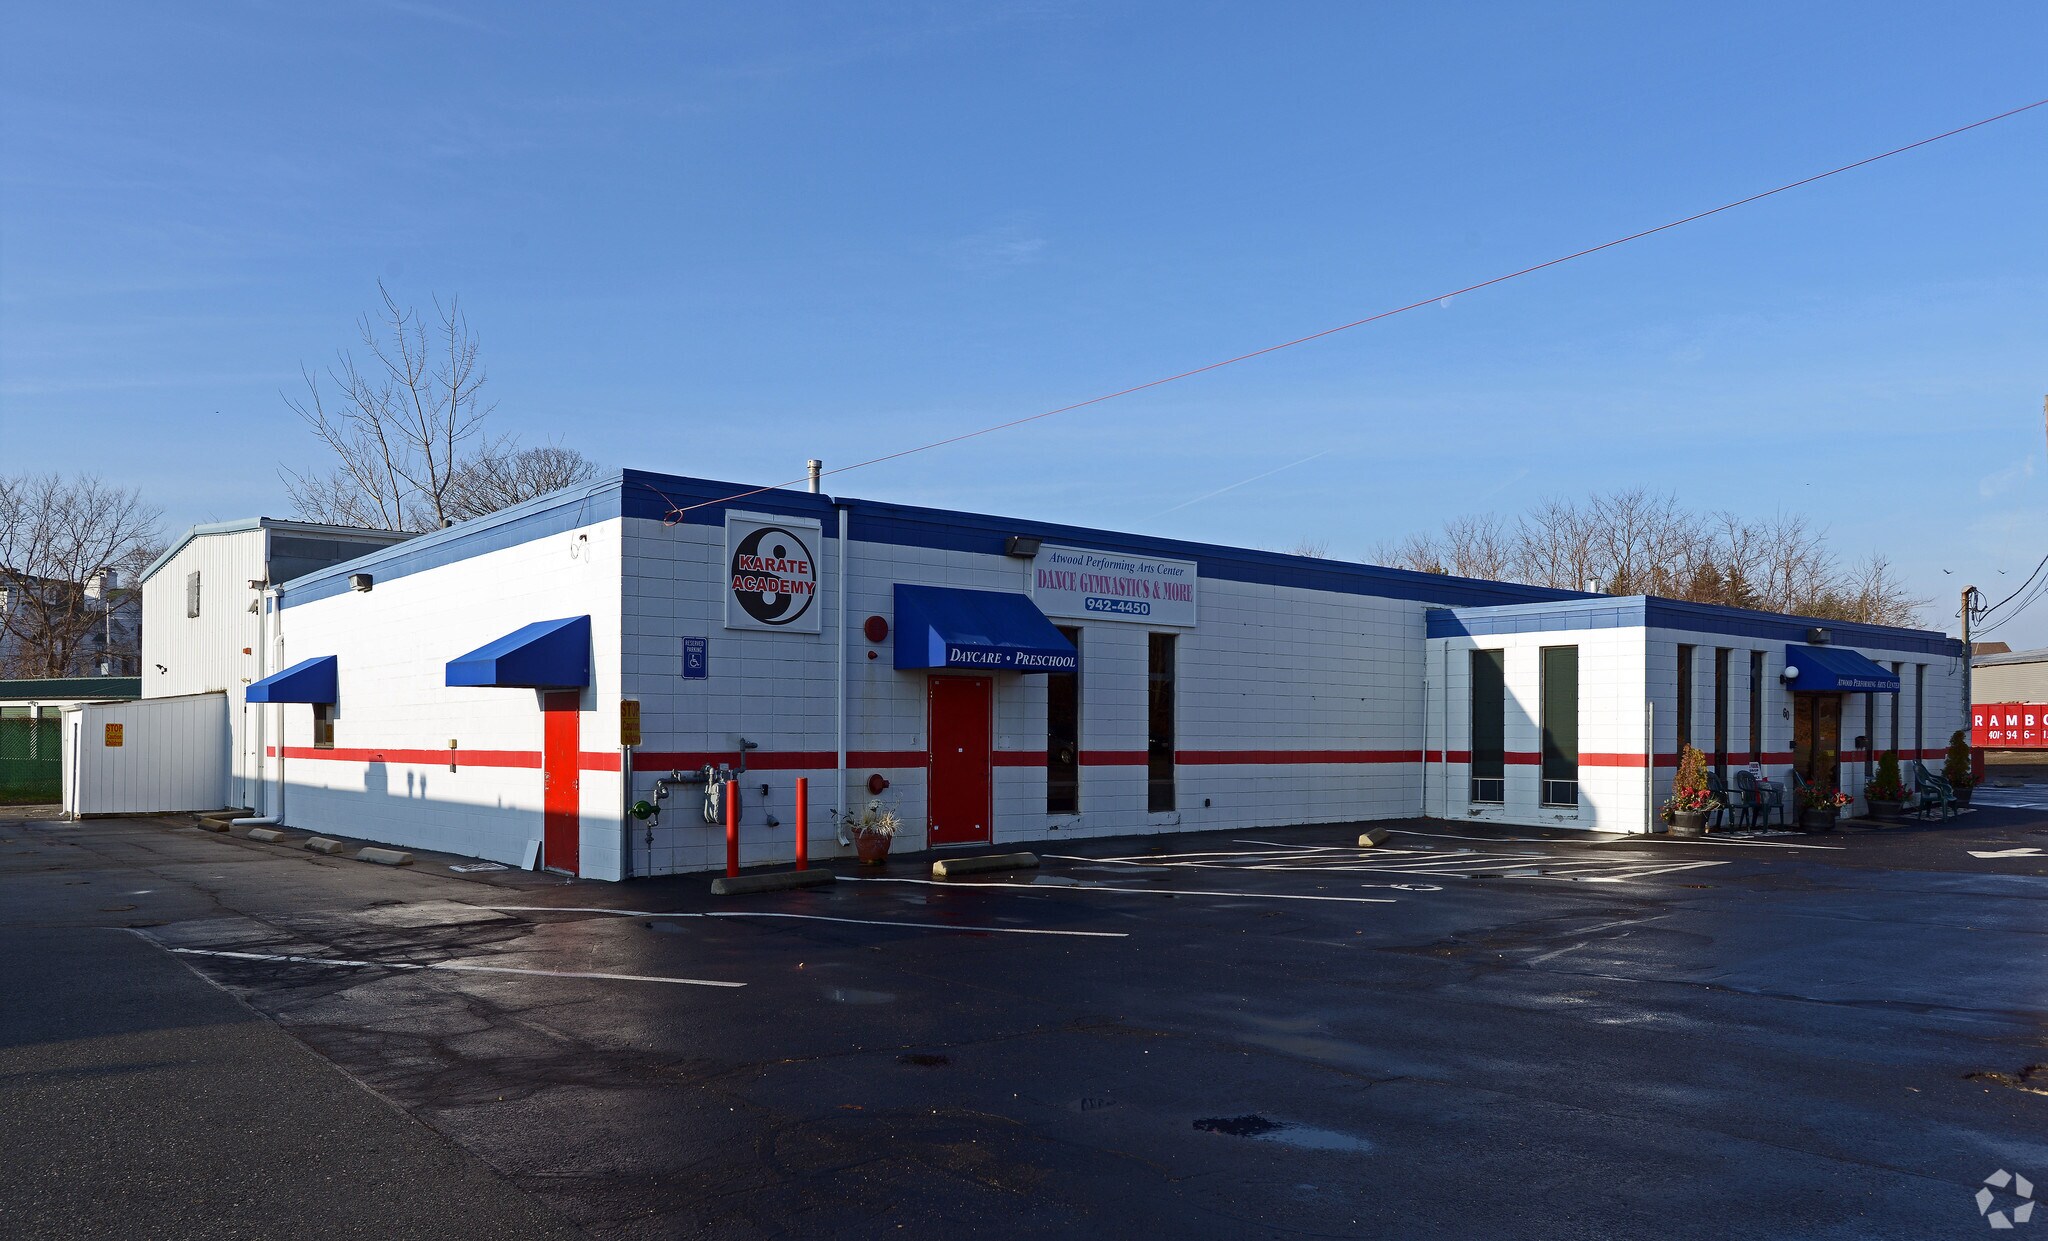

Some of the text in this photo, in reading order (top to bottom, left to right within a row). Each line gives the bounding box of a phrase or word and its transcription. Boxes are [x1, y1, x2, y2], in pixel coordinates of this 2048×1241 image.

[739, 554, 808, 574] KARATE
[1049, 551, 1184, 577] Atwood Performing Arts Center
[731, 575, 816, 595] ACADEMY
[1037, 568, 1193, 603] DANCE GYMNASTICS & MORE
[1087, 598, 1149, 615] 942-4450
[1783, 707, 1790, 721] 60
[106, 724, 122, 732] STOP
